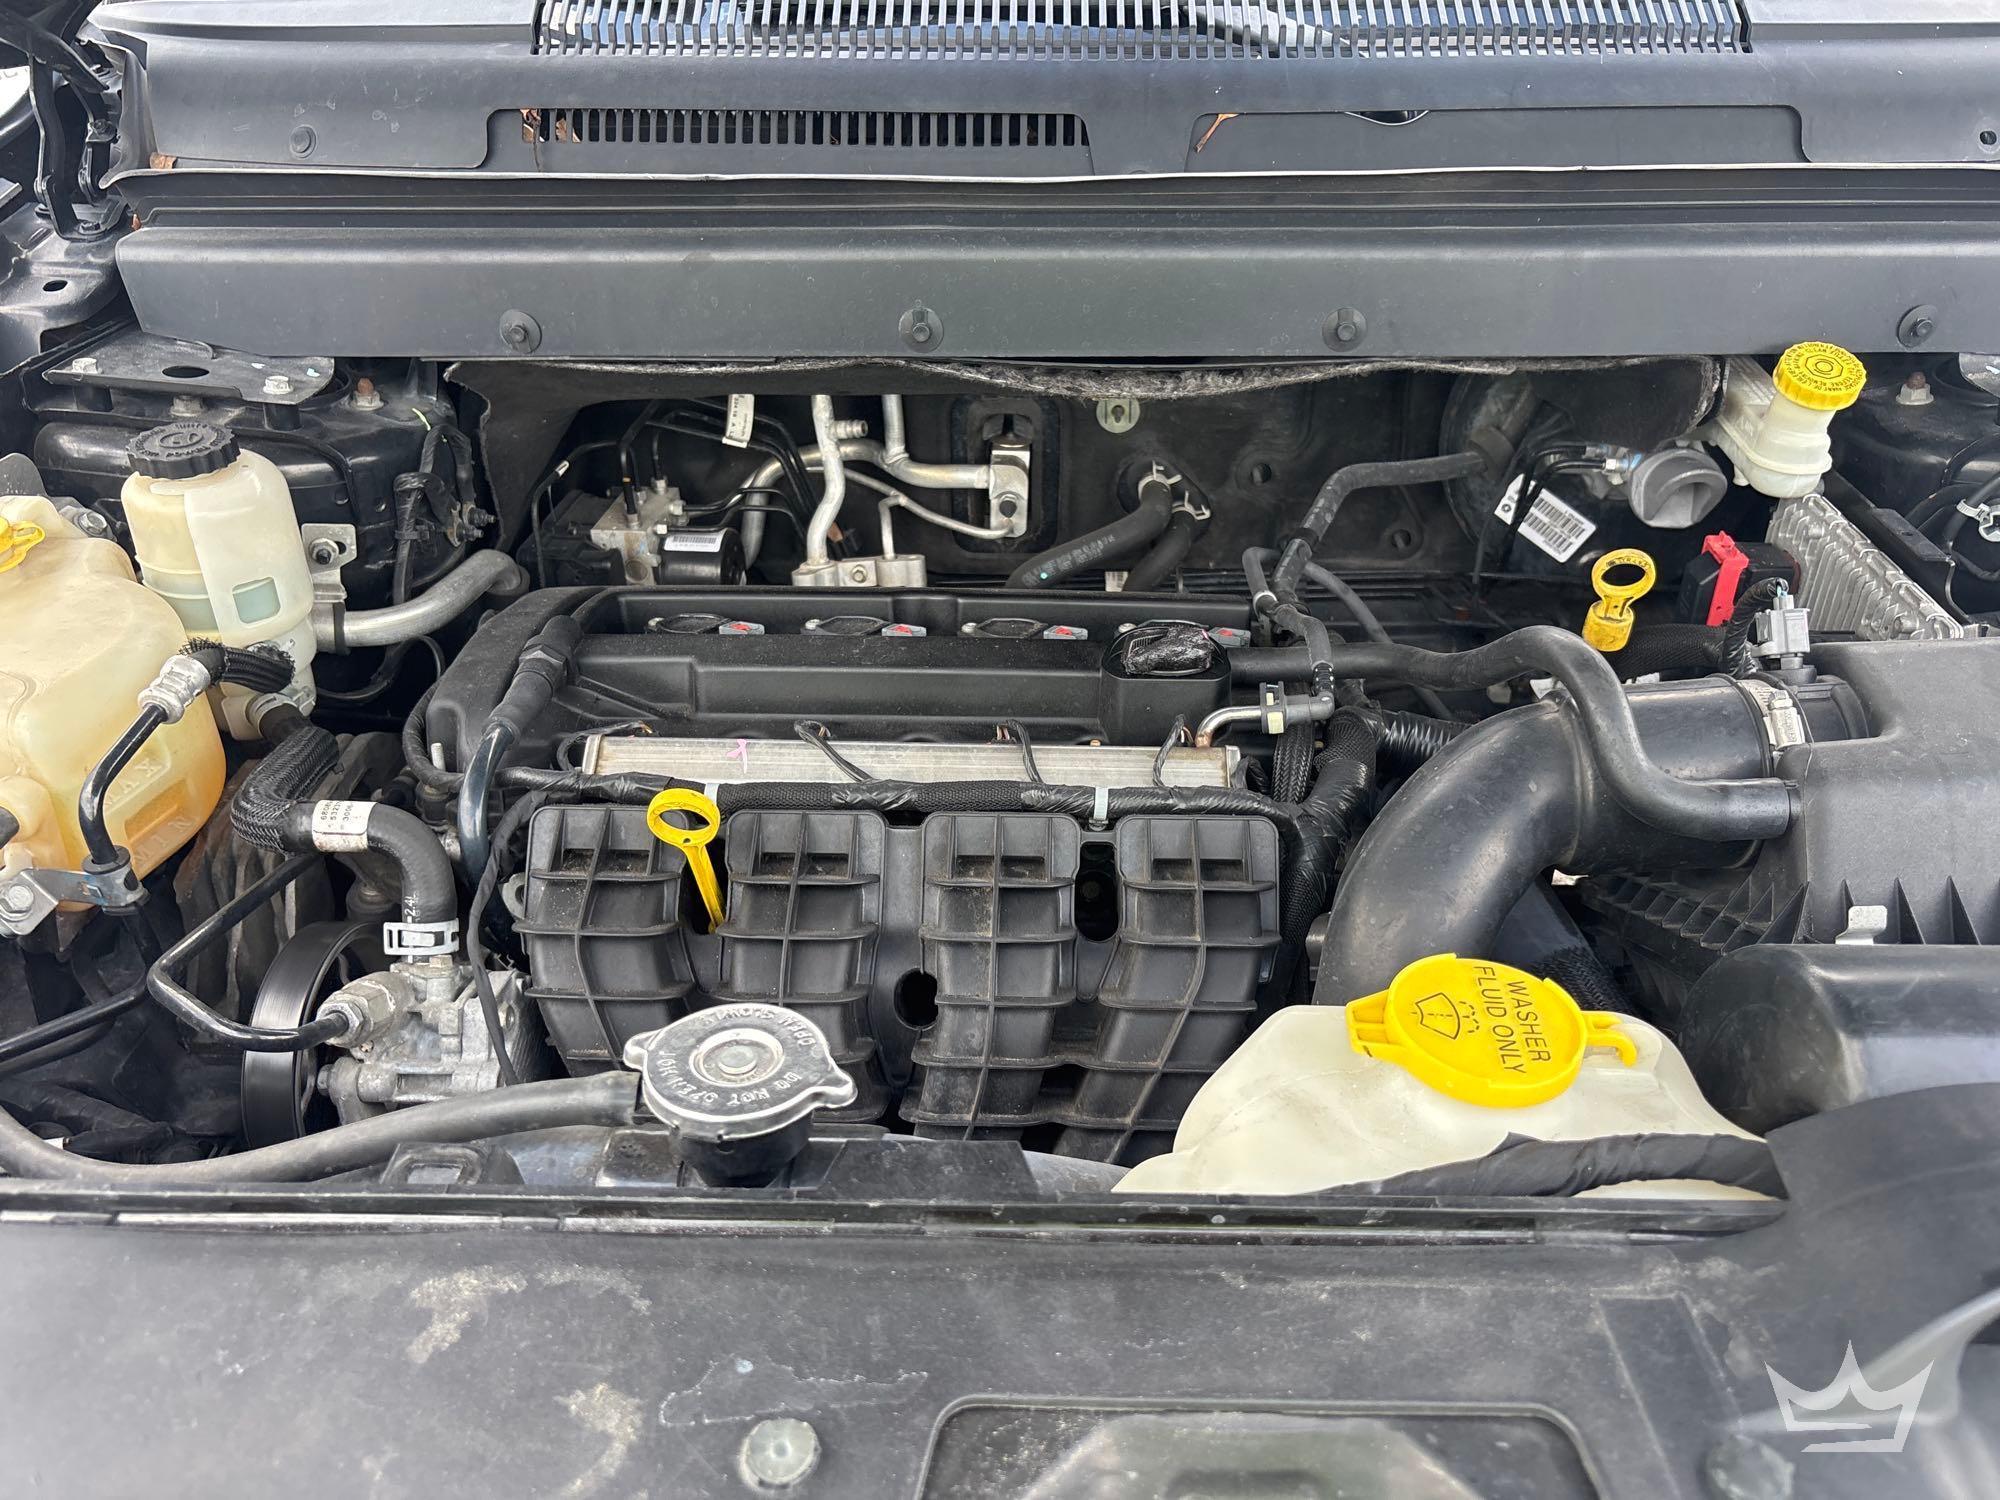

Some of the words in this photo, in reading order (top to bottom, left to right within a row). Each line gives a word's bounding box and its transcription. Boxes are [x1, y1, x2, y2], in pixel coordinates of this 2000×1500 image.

[1473, 965, 1507, 1018] FLUID
[1491, 1023, 1527, 1074] ONLY
[1505, 980, 1551, 1063] WASHER
[669, 1076, 719, 1104] OPEN
[775, 1071, 803, 1092] DO
[726, 1088, 770, 1107] NOT
